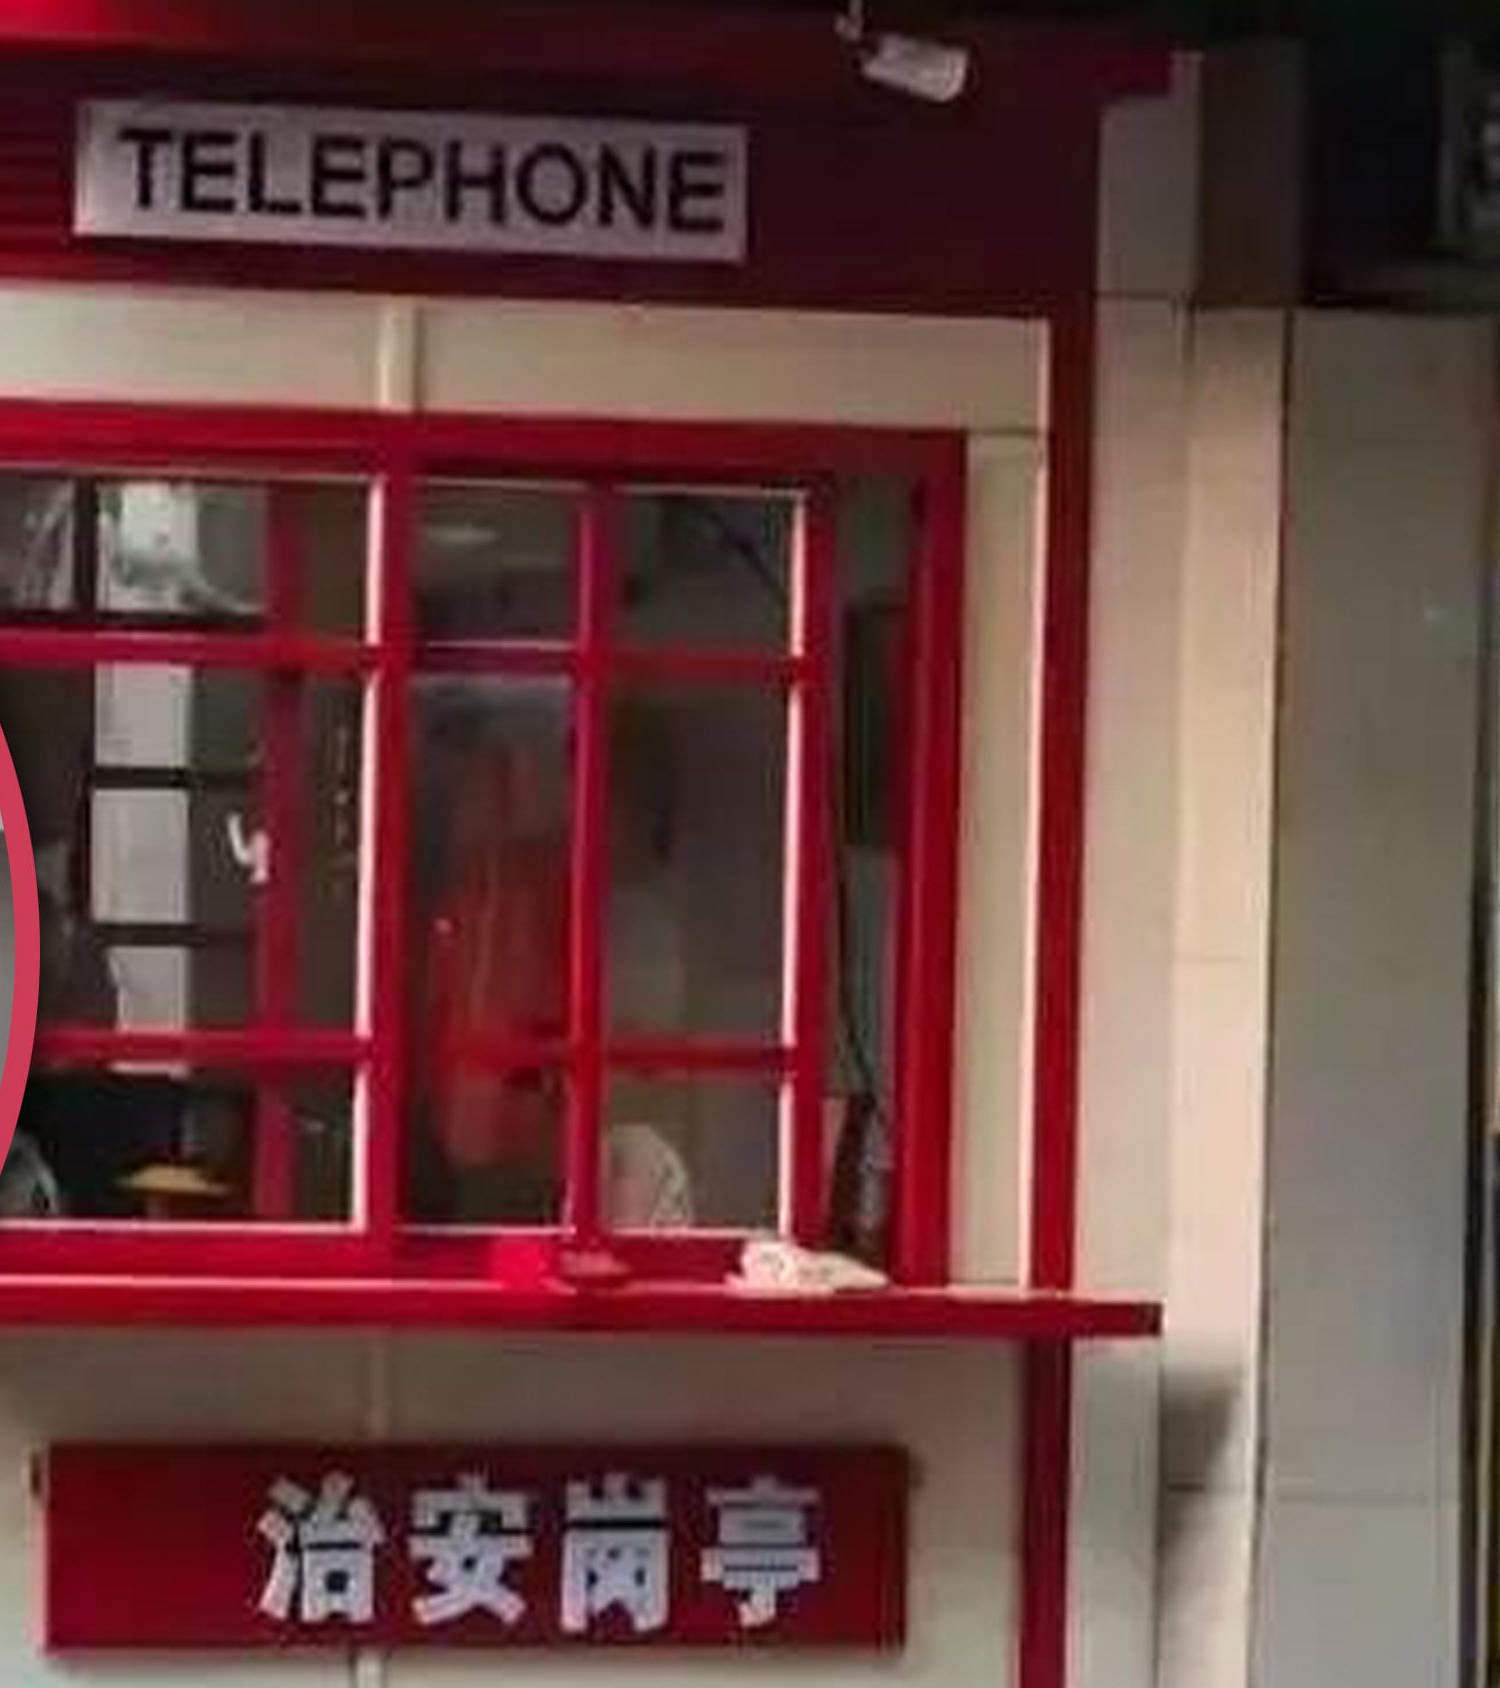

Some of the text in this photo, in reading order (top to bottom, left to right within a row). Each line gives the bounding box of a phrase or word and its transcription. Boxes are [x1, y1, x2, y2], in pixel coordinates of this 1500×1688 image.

[119, 127, 726, 233] TELEPHONE
[257, 1472, 821, 1632] 治安岗亭
